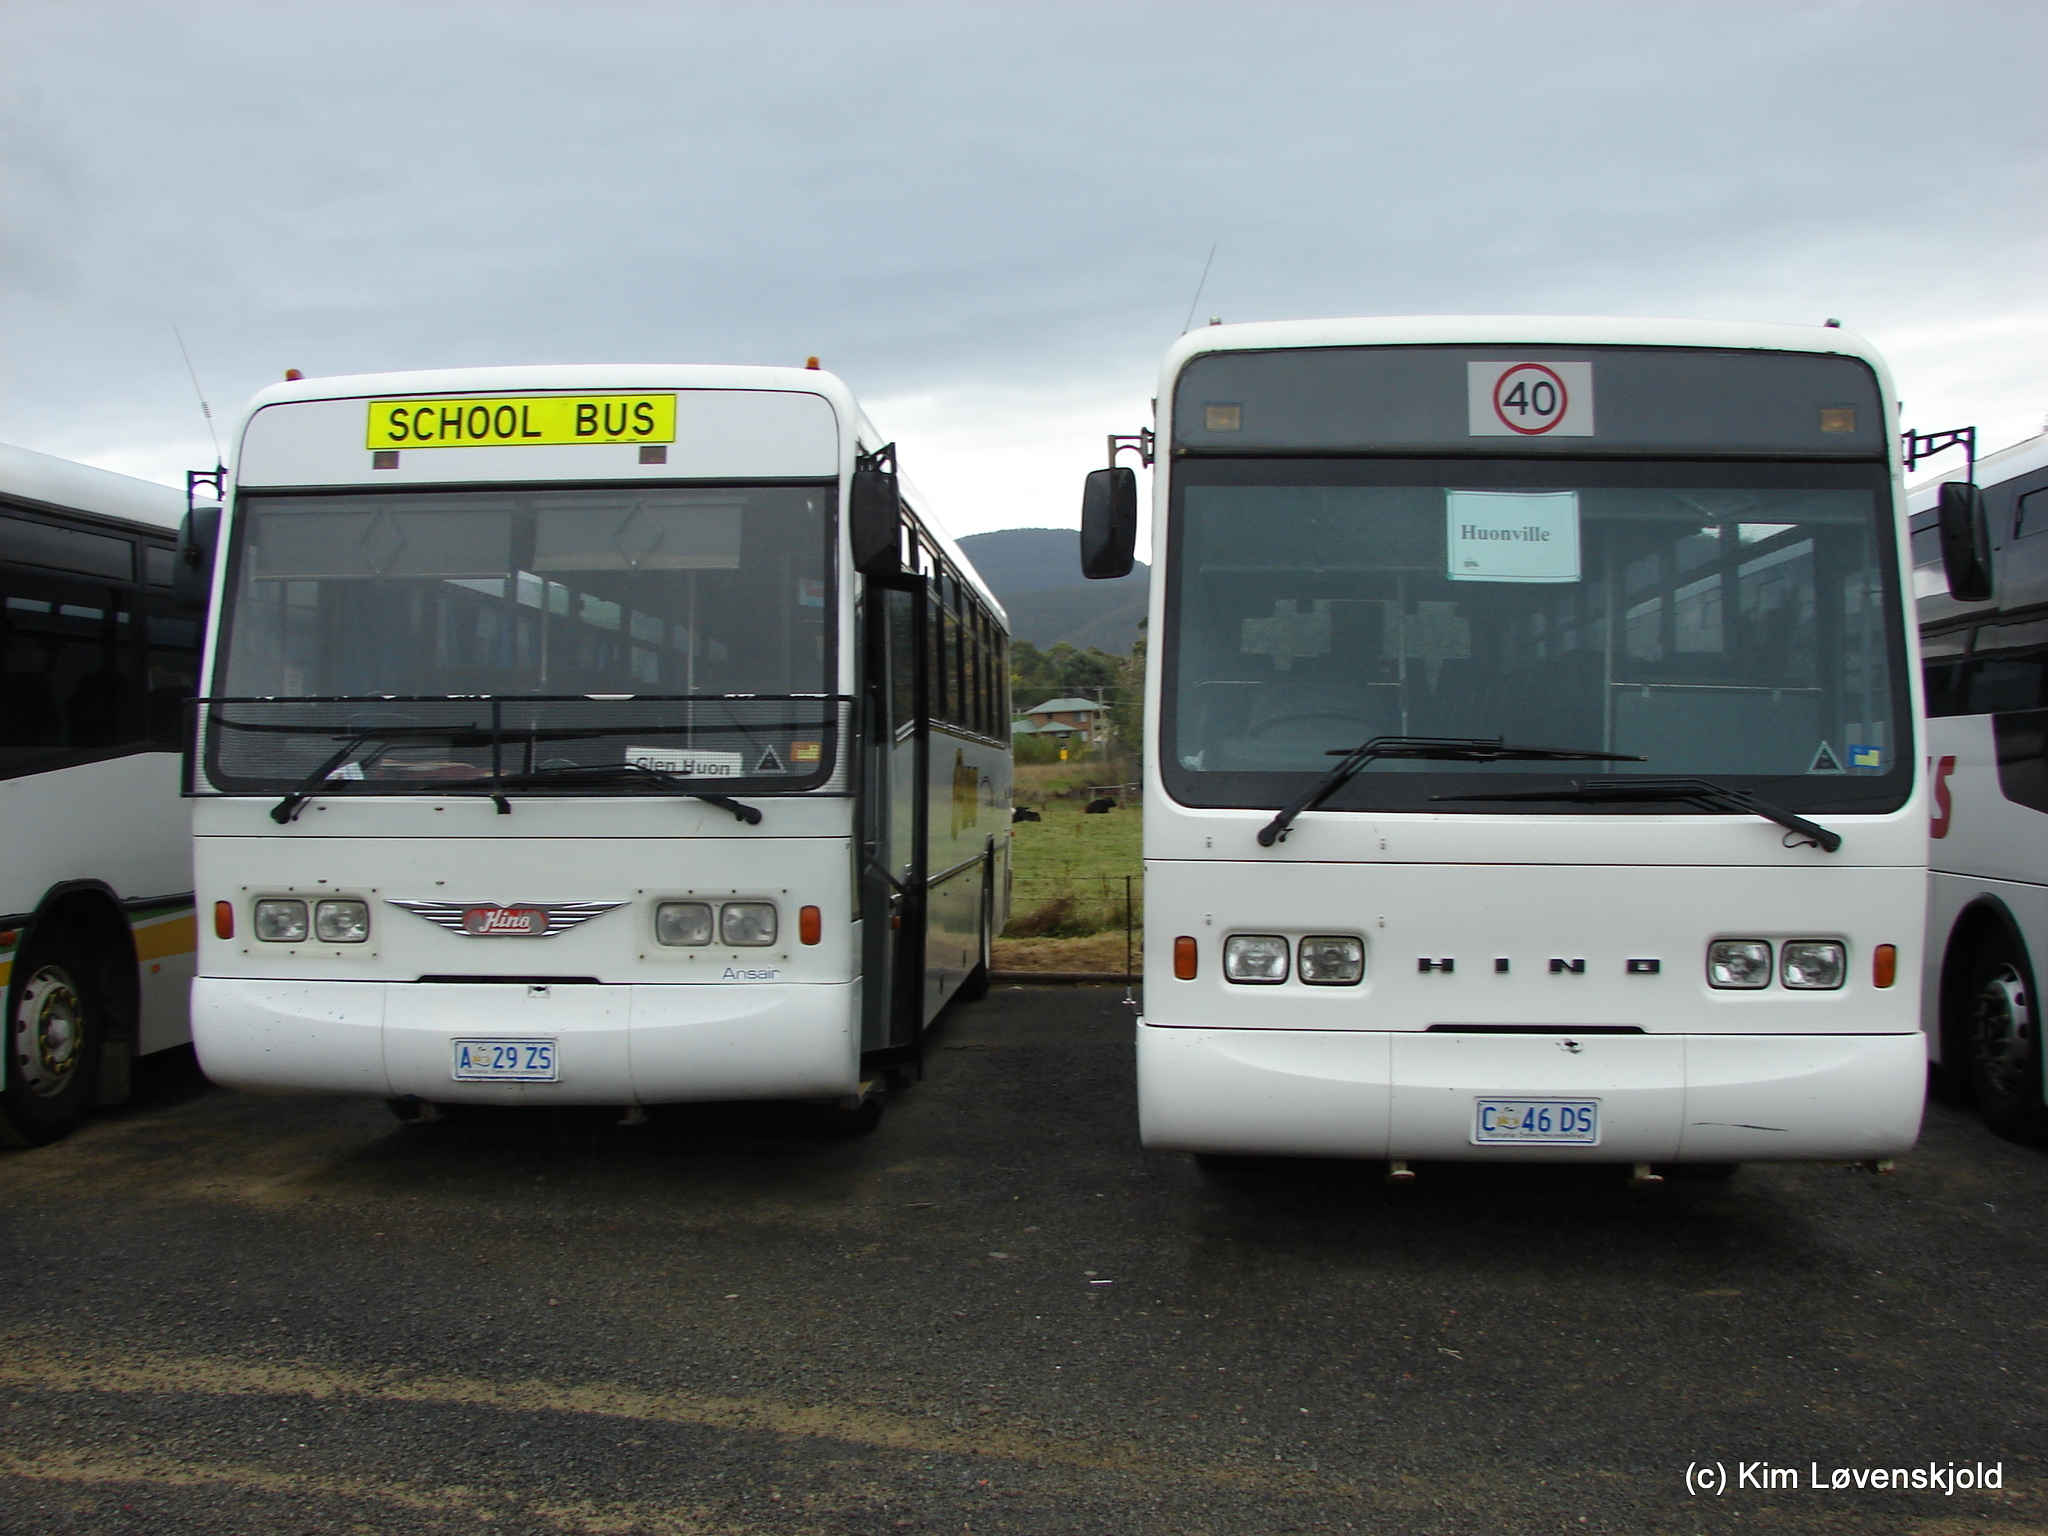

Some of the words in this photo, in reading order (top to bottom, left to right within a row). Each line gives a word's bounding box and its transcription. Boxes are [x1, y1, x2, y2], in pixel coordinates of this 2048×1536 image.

[1502, 380, 1556, 416] 40
[387, 404, 542, 441] SCHOOL
[575, 402, 654, 436] BUS
[1461, 524, 1550, 542] Huonville
[683, 759, 730, 775] Huon
[1927, 755, 1956, 839] S
[478, 909, 531, 932] Hino
[722, 966, 781, 980] Ansair
[1418, 957, 1661, 974] HINO
[460, 1046, 472, 1069] A
[493, 1046, 517, 1069] 29
[525, 1046, 551, 1070] ZS
[1482, 1106, 1497, 1131] C
[1521, 1107, 1551, 1132] 46
[1560, 1107, 1592, 1133] DS
